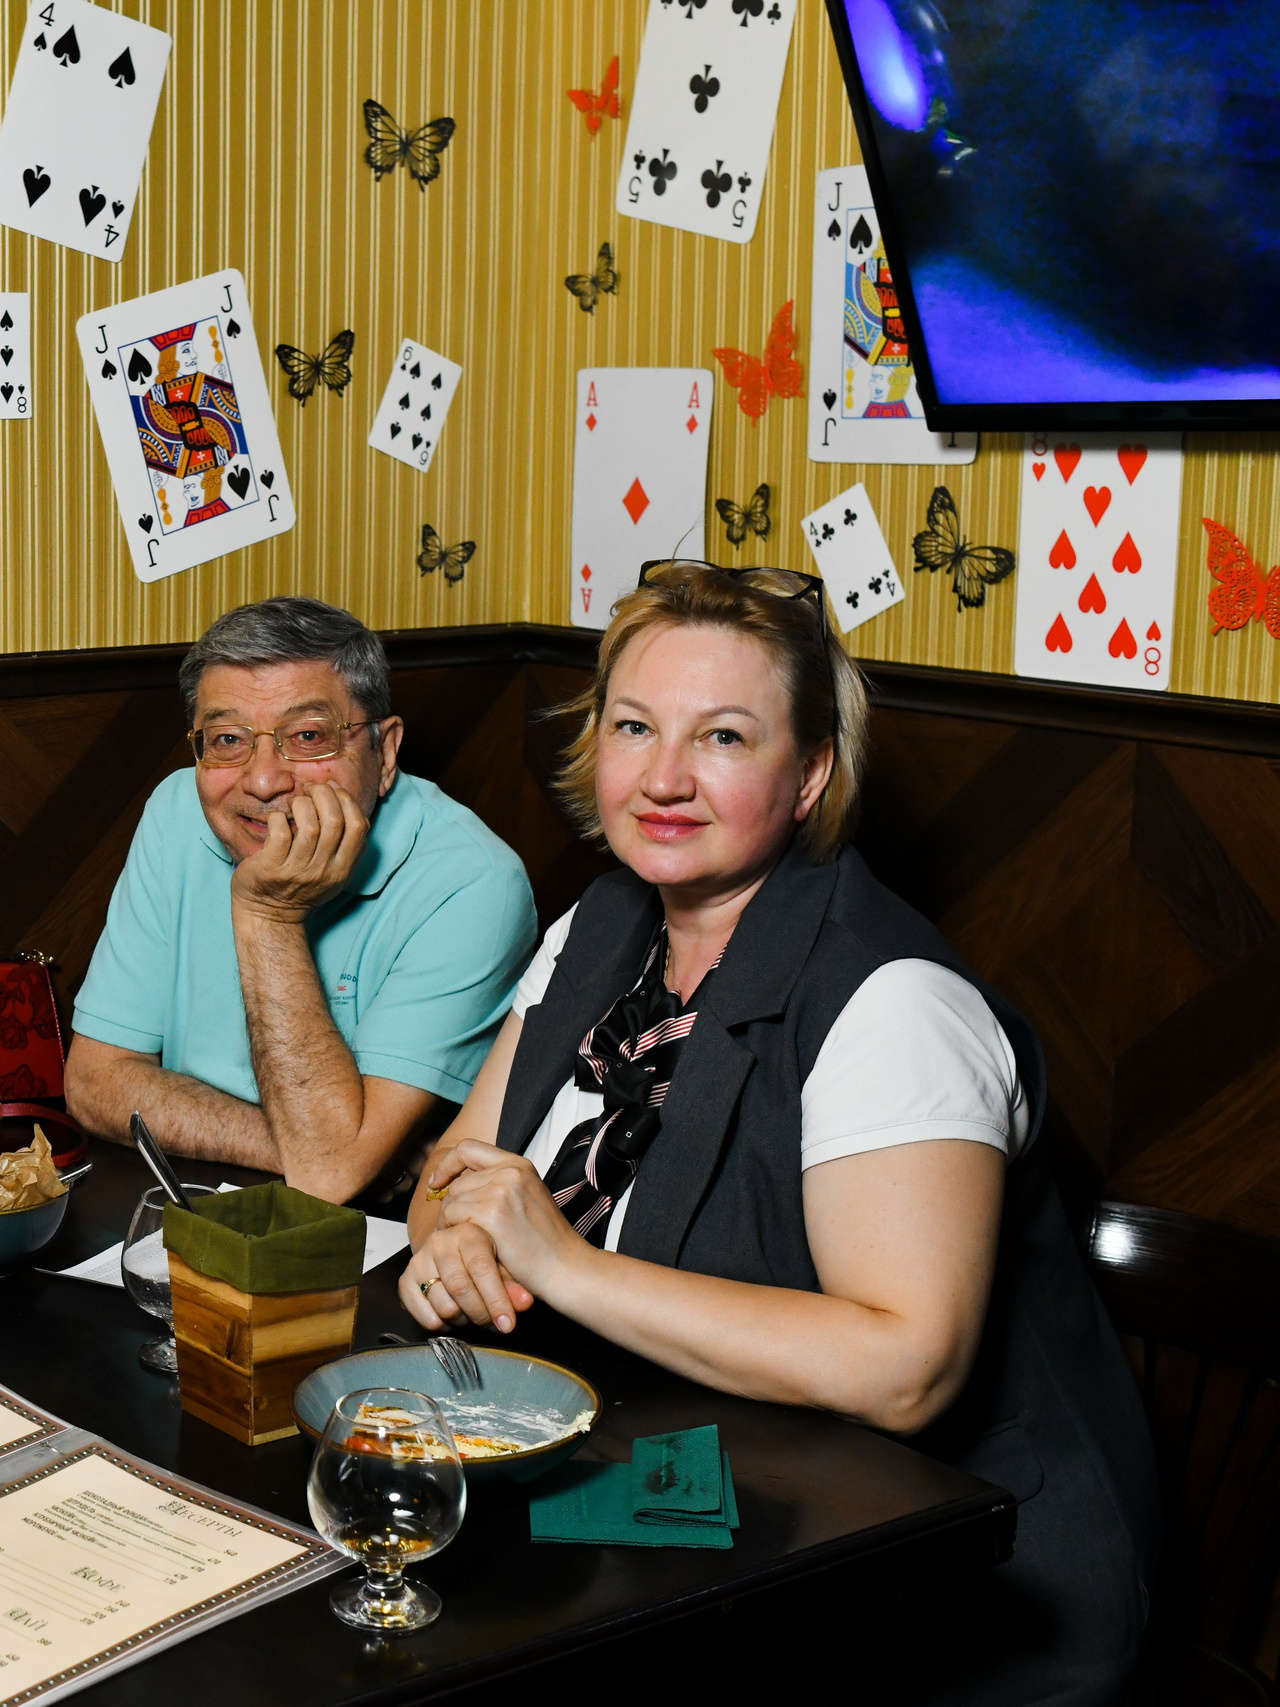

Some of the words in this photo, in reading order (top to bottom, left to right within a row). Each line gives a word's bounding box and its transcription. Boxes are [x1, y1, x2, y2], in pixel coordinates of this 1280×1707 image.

[39, 3, 54, 26] 4
[629, 176, 641, 203] 5
[828, 182, 842, 211] J
[733, 200, 746, 228] 5
[105, 225, 119, 247] 4
[221, 285, 232, 313] J
[96, 325, 108, 354] J
[403, 346, 413, 361] 6
[17, 397, 27, 413] 8
[586, 381, 598, 407] A
[688, 382, 700, 408] A
[822, 418, 836, 446] J
[420, 451, 428, 465] 6
[268, 494, 279, 522] J
[810, 522, 818, 536] 4
[148, 539, 159, 567] J
[581, 588, 592, 613] A
[886, 582, 895, 596] 4
[1144, 647, 1159, 676] 8
[51, 1505, 76, 1518] ЧИЗКЕЙК
[64, 1497, 95, 1513] ШТРУДЕЛЬ
[82, 1490, 124, 1510] ШОКОЛАДНЫЙ
[122, 1509, 148, 1521] ФОНДАН
[156, 1500, 241, 1536] ДЕСЕРТЫ
[32, 1512, 72, 1531] КЛУБНИЧНЫЙ
[71, 1529, 96, 1543] ЧИЗКЕЙК
[22, 1517, 55, 1535] МОРОЖЕНОЕ
[163, 1577, 177, 1585] 170
[72, 1566, 125, 1593] КОФЕ
[6, 1607, 48, 1631] ЧАЙ
